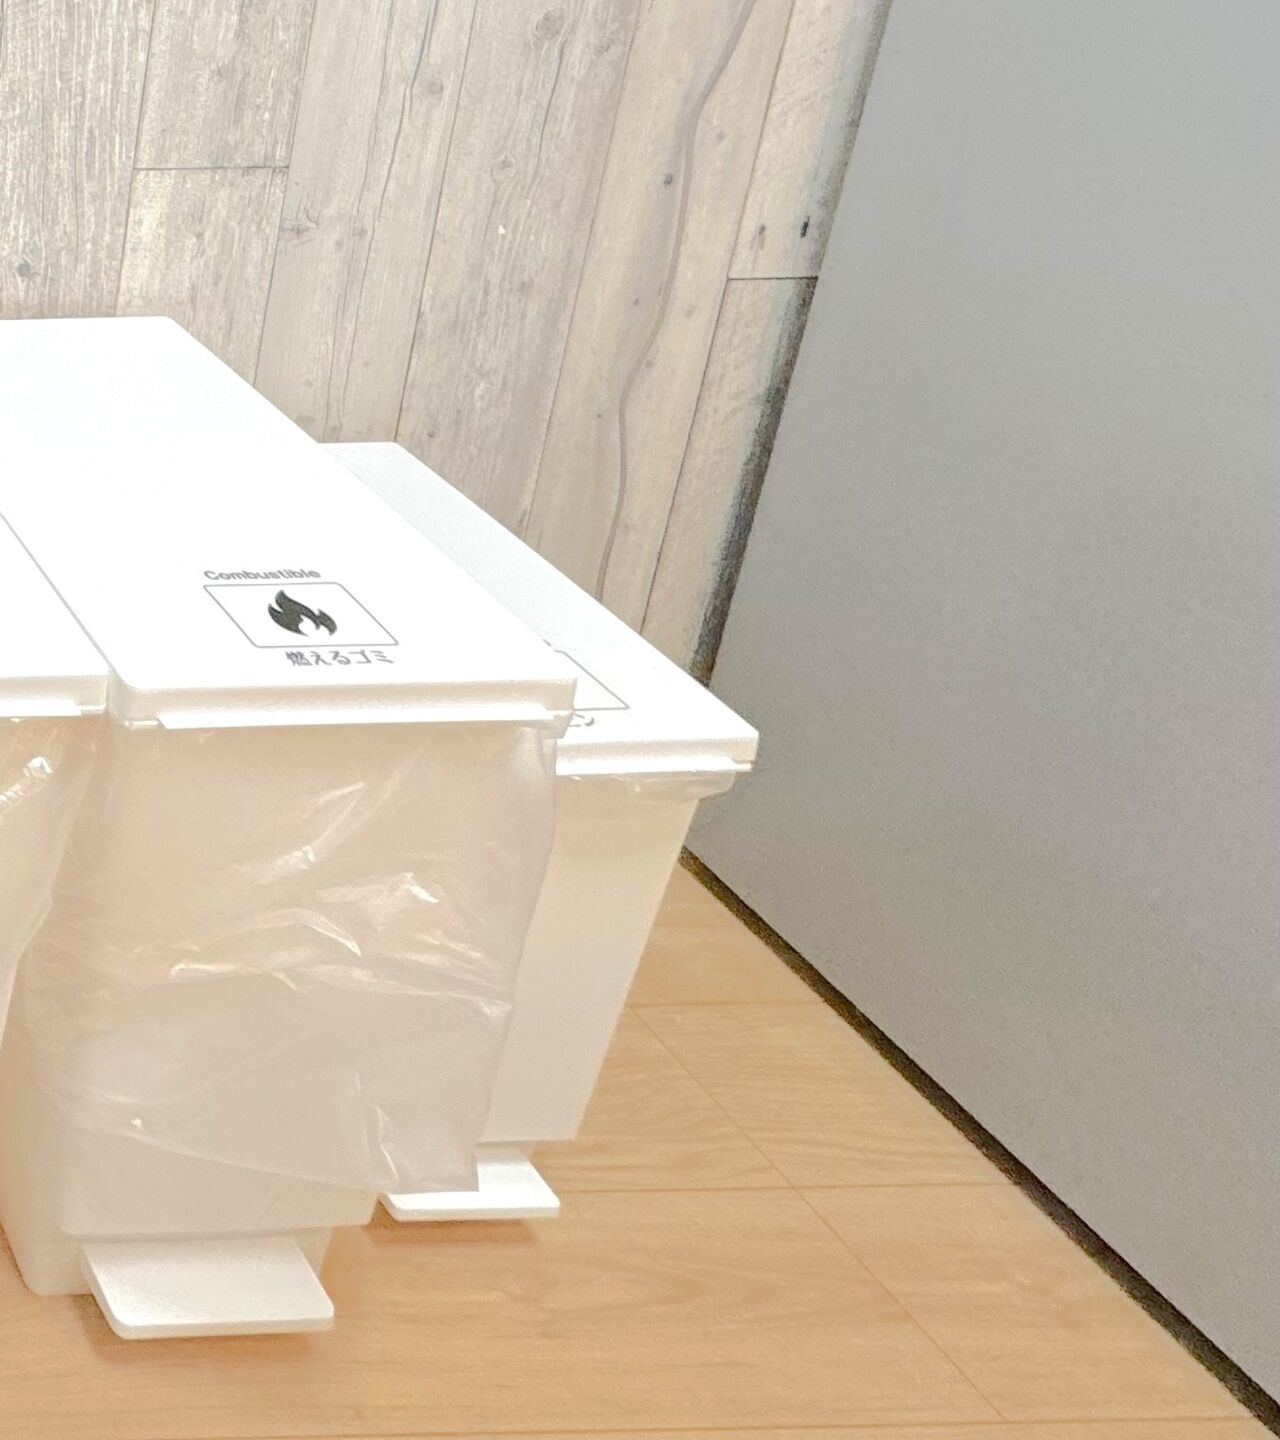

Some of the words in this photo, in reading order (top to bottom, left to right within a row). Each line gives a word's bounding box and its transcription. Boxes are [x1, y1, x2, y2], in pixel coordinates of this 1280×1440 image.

[203, 568, 322, 581] Combustible
[285, 648, 395, 667] 燃えるゴミ
